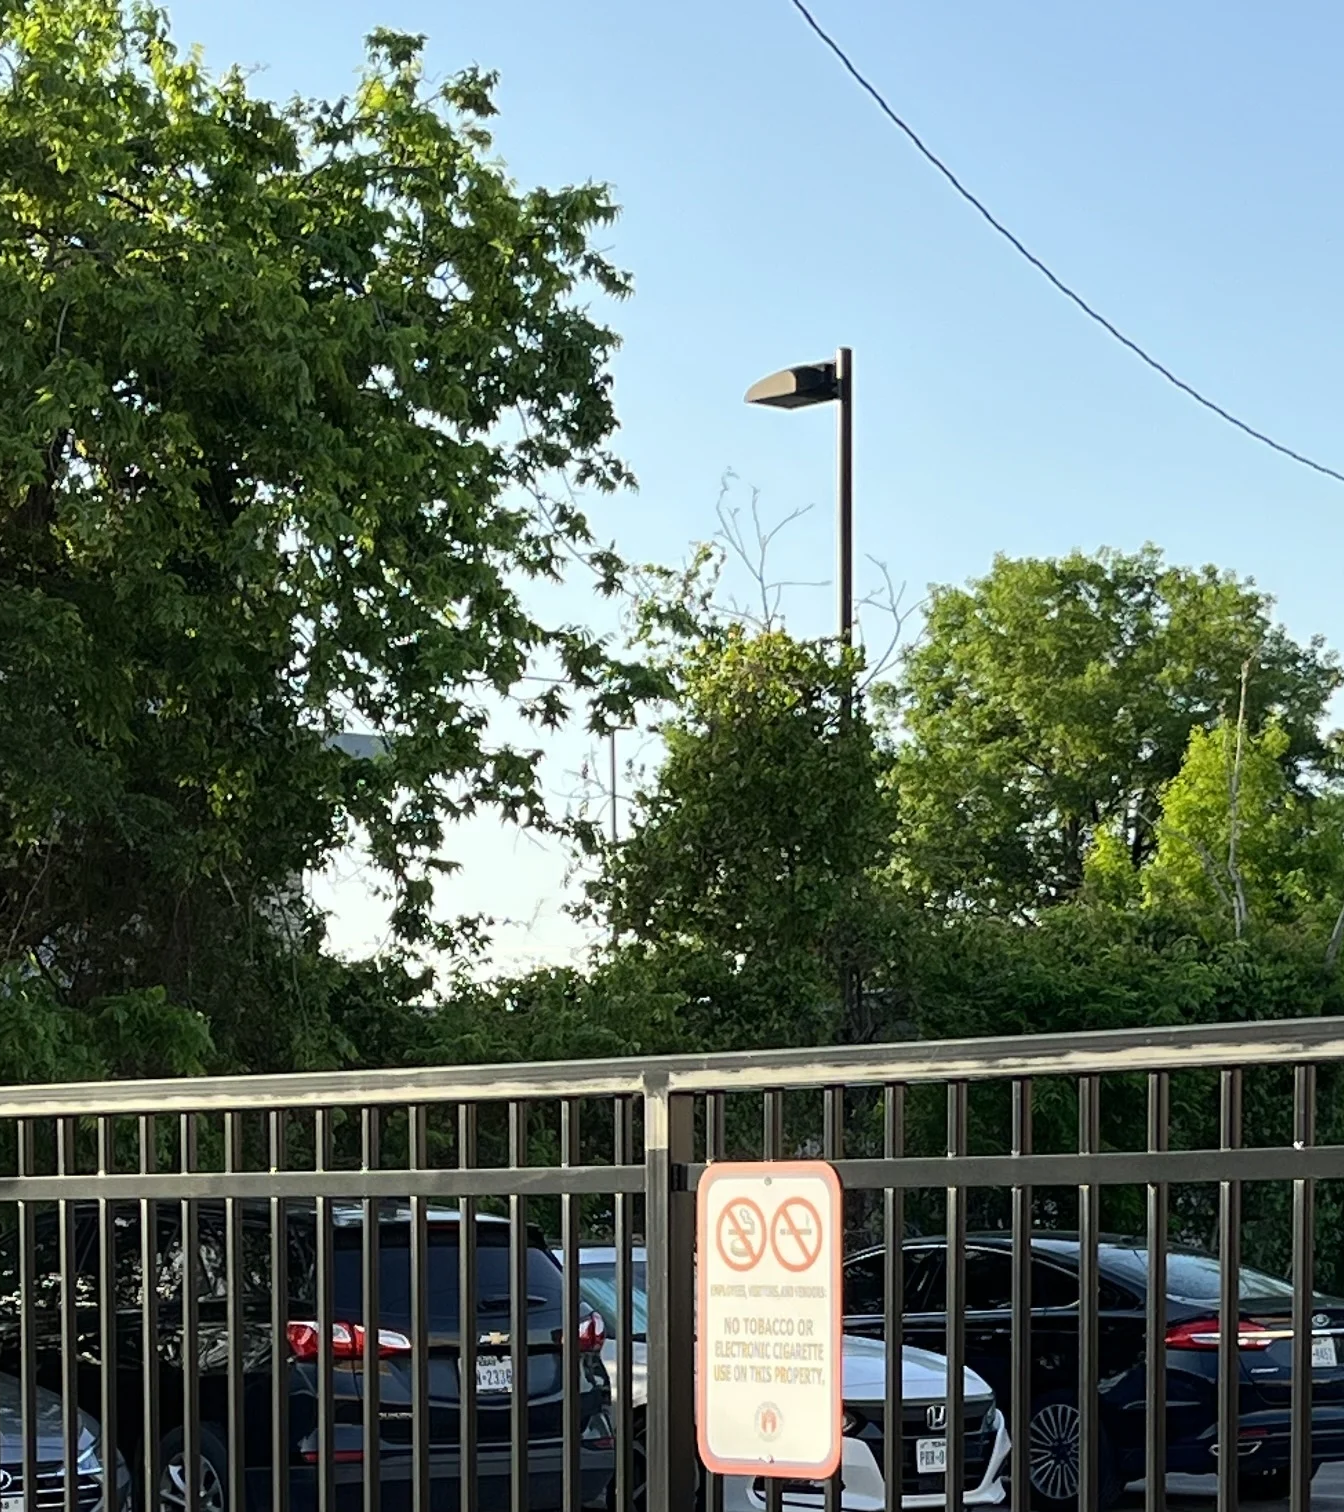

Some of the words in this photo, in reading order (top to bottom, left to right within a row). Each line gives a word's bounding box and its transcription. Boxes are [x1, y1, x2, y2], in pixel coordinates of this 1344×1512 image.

[724, 1317, 740, 1335] NO
[743, 1317, 794, 1336] TOBACCO
[797, 1319, 814, 1336] OR
[714, 1340, 771, 1359] ELECTRONIC
[773, 1342, 825, 1361] CIGARETTE
[713, 1364, 732, 1382] USE
[734, 1365, 747, 1382] ON
[749, 1365, 772, 1383] THIS
[774, 1366, 826, 1386] PROPERTY.
